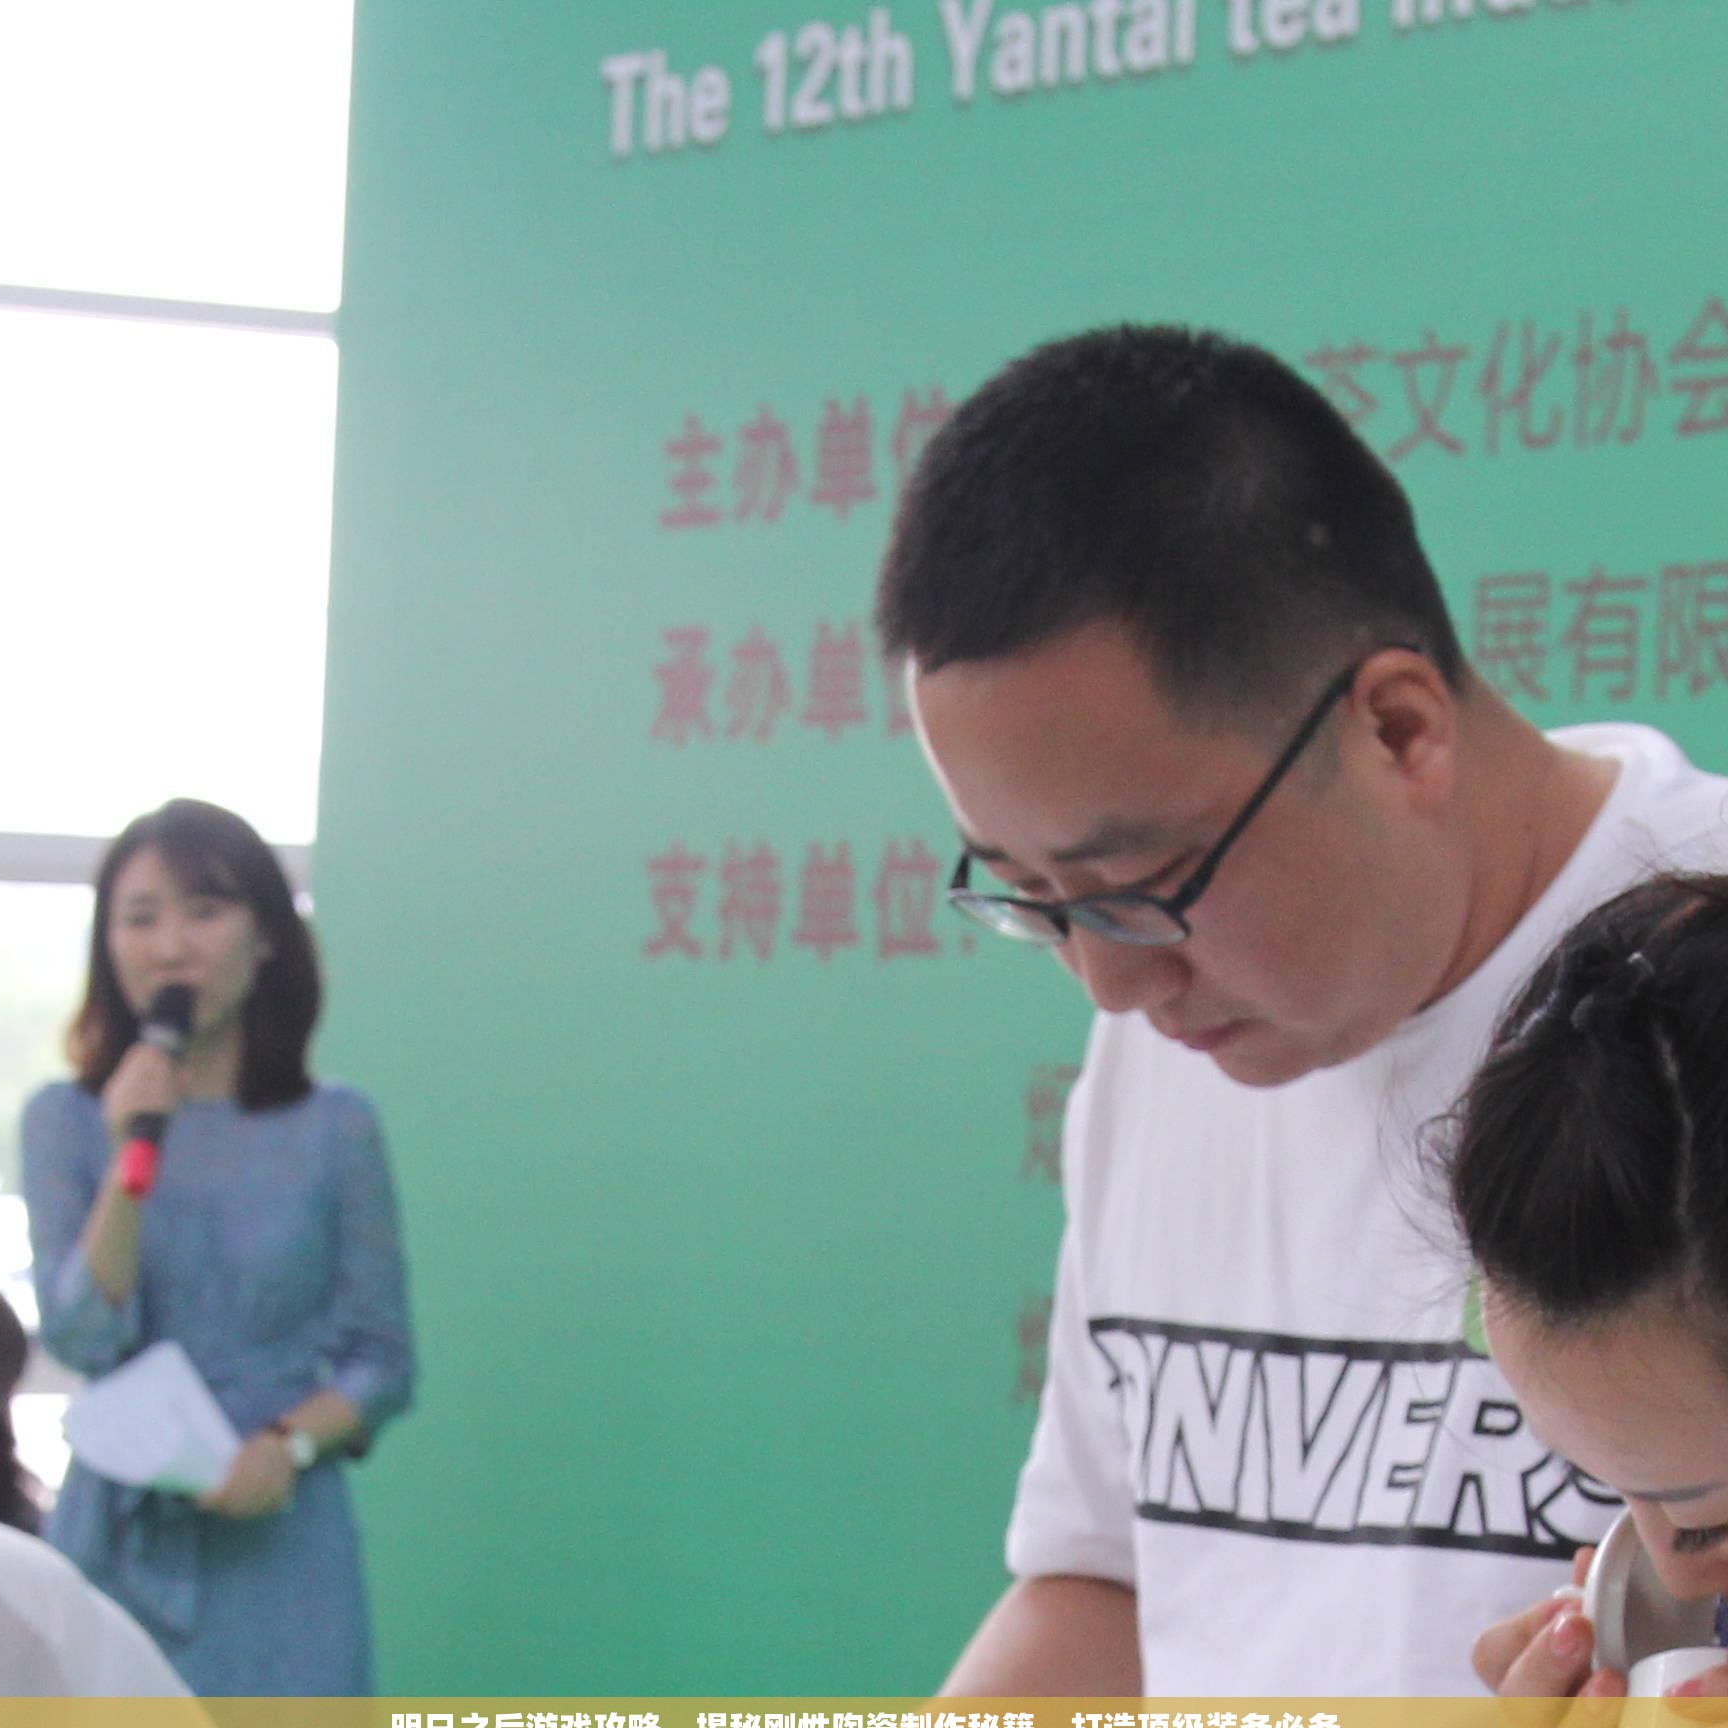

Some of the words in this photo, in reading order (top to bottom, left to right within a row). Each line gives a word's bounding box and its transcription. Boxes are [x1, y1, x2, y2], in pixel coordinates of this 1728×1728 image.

[600, 48, 731, 156] The
[756, 8, 914, 132] 12th
[937, 0, 1198, 100] Yantai
